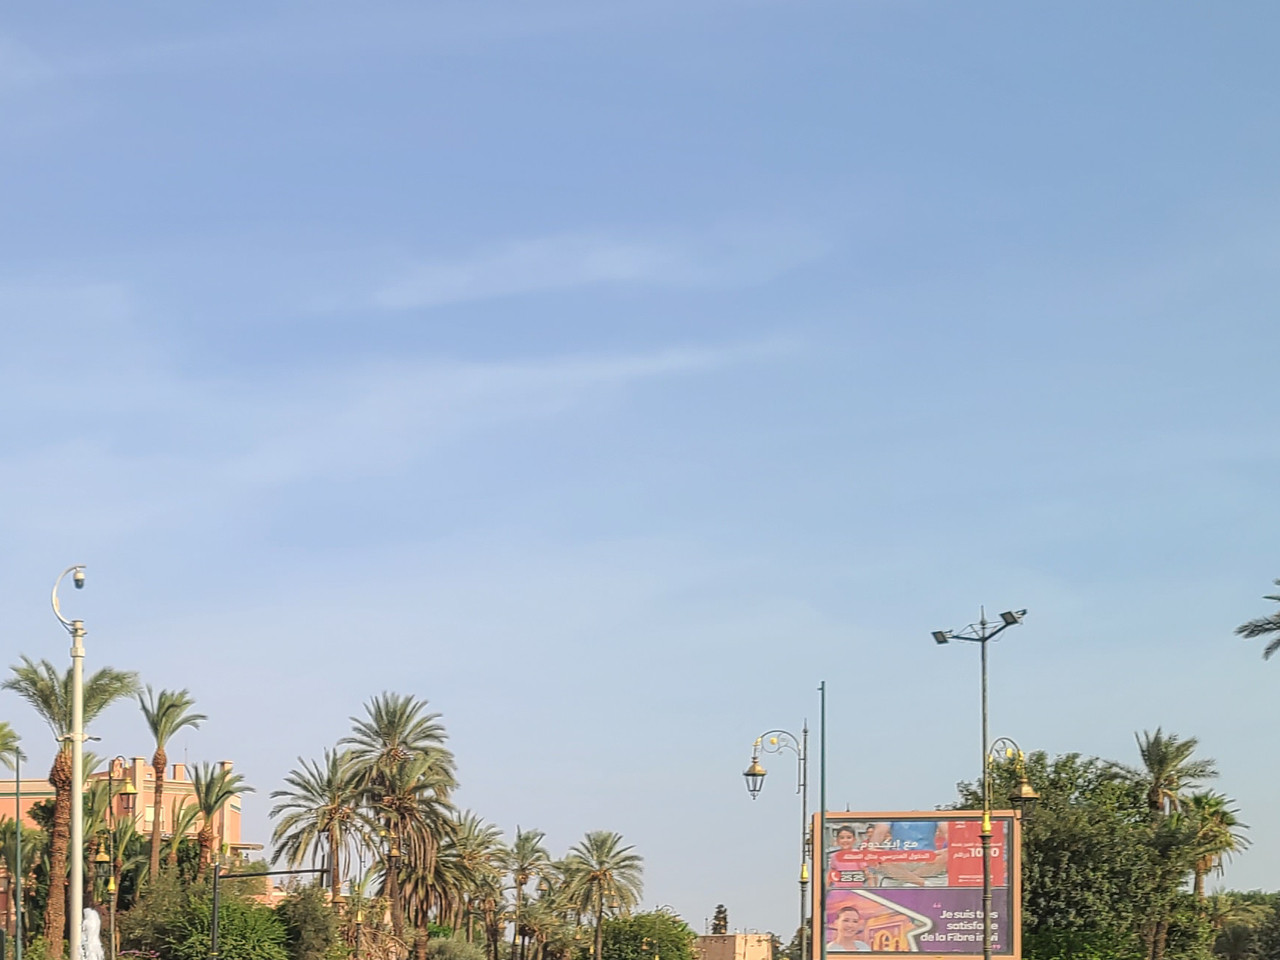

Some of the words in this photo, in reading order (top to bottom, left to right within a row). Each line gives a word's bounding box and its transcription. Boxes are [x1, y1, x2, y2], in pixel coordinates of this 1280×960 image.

[939, 910, 954, 919] Je
[954, 909, 976, 919] suis
[920, 932, 935, 942] de
[935, 932, 946, 942] la
[947, 932, 975, 942] Fibre
